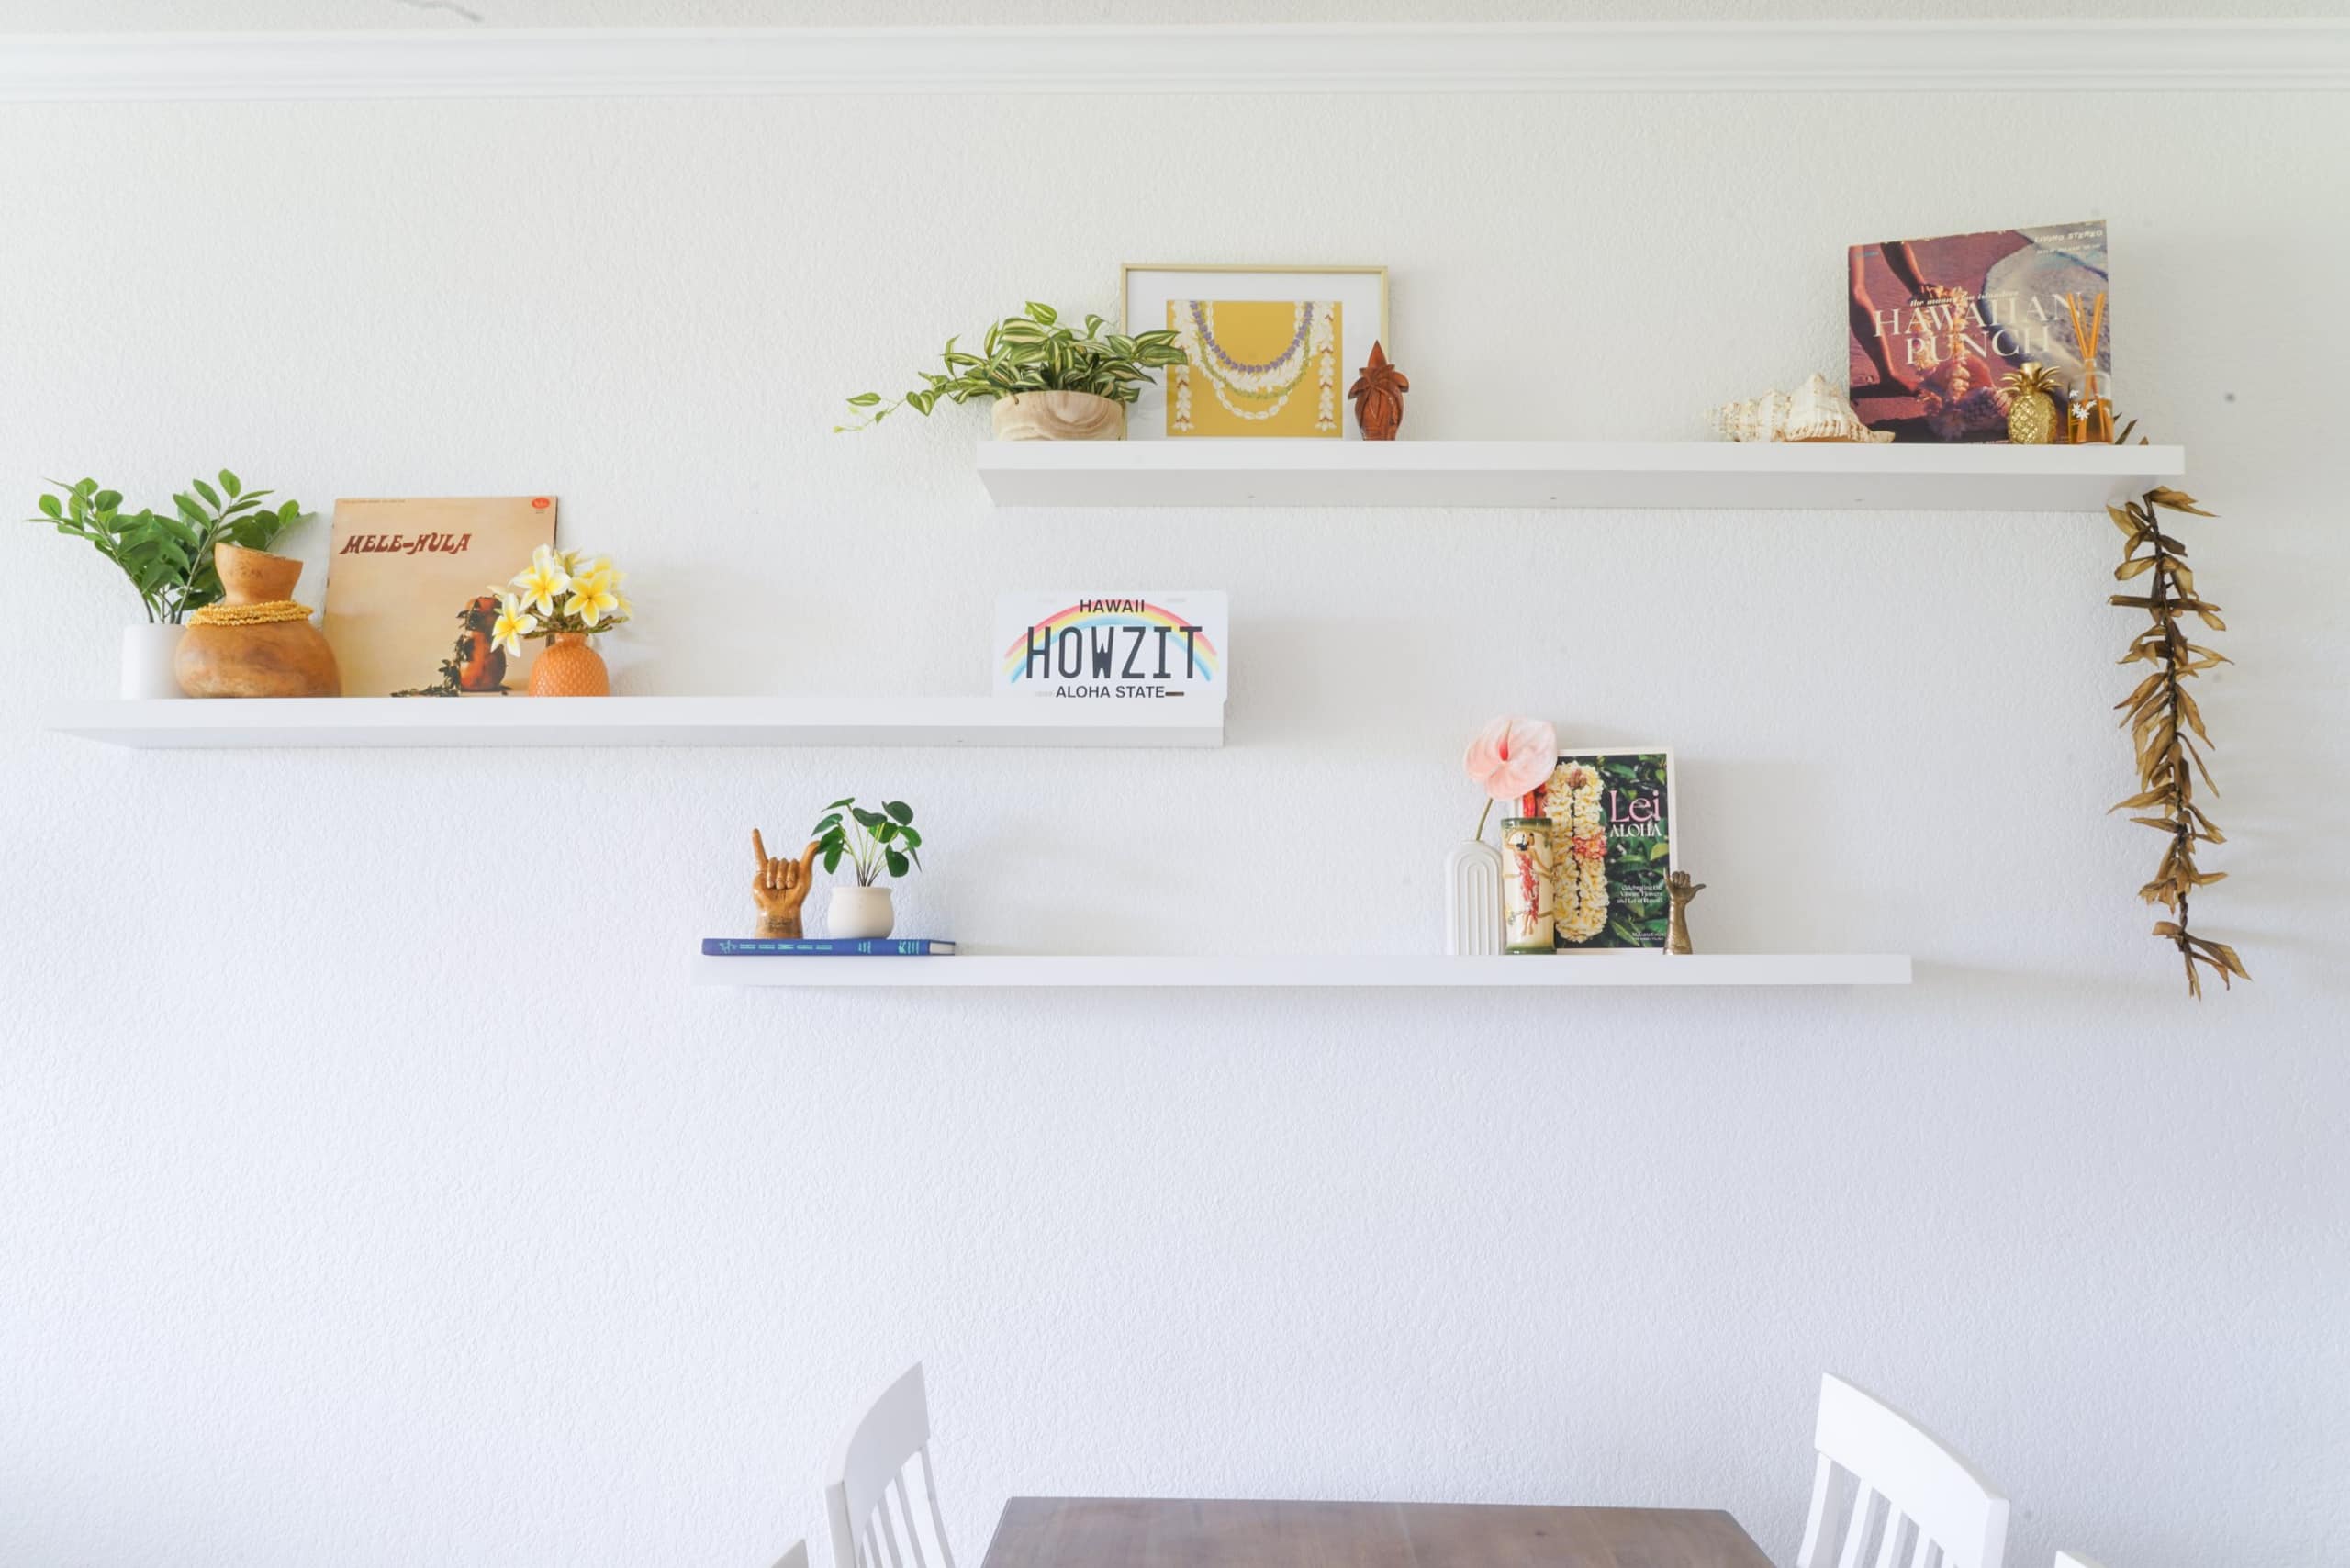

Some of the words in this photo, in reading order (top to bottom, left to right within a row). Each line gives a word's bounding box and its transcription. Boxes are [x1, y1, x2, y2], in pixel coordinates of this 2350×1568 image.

[1874, 291, 2083, 338] HAWAIIAN
[1905, 325, 2051, 365] PUNCH
[338, 532, 472, 555] MELE-HULA
[1080, 599, 1146, 613] HAWAII
[1025, 625, 1203, 679] HOWZIT
[1056, 685, 1111, 699] ALOHA
[1115, 685, 1166, 699] STATE
[1609, 790, 1661, 823] Lei
[1610, 823, 1662, 838] ALOHA
